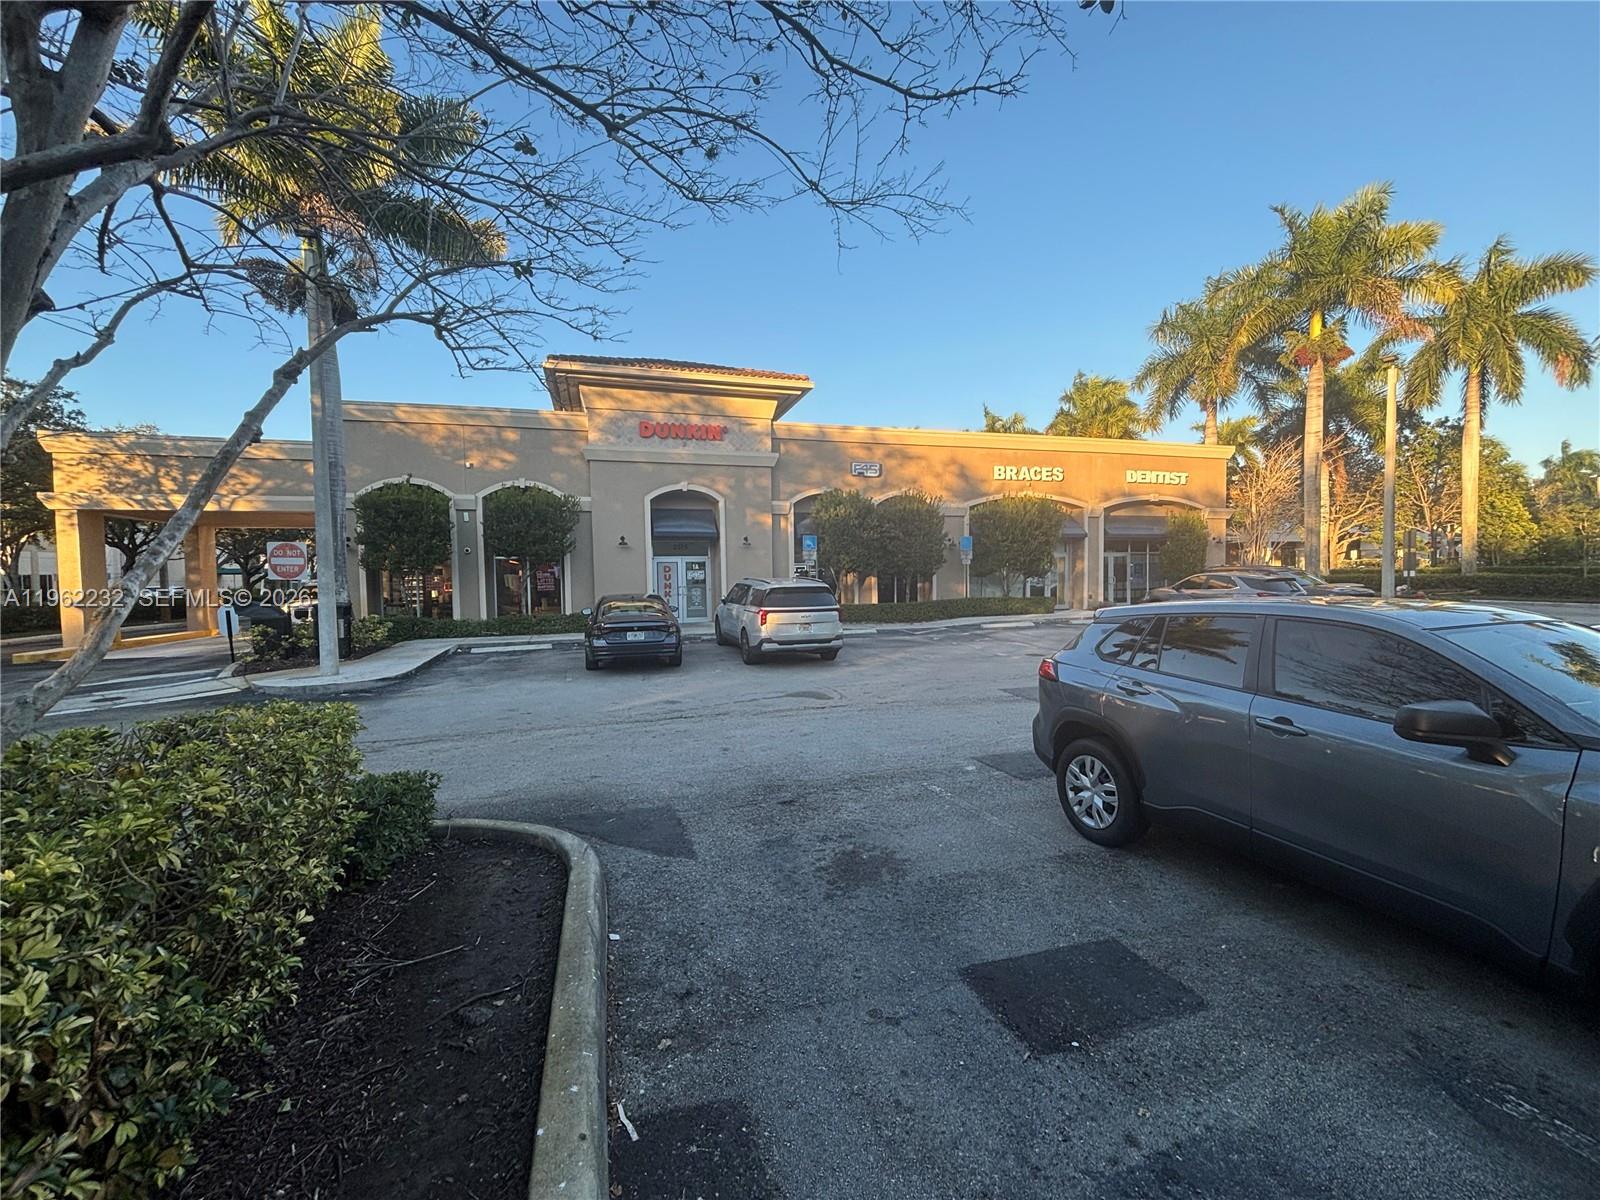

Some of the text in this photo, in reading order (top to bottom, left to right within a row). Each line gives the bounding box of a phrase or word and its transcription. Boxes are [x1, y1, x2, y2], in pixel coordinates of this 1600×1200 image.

[992, 465, 1065, 482] BRACES
[1125, 469, 1190, 485] DENTIST
[276, 565, 299, 573] ENTER
